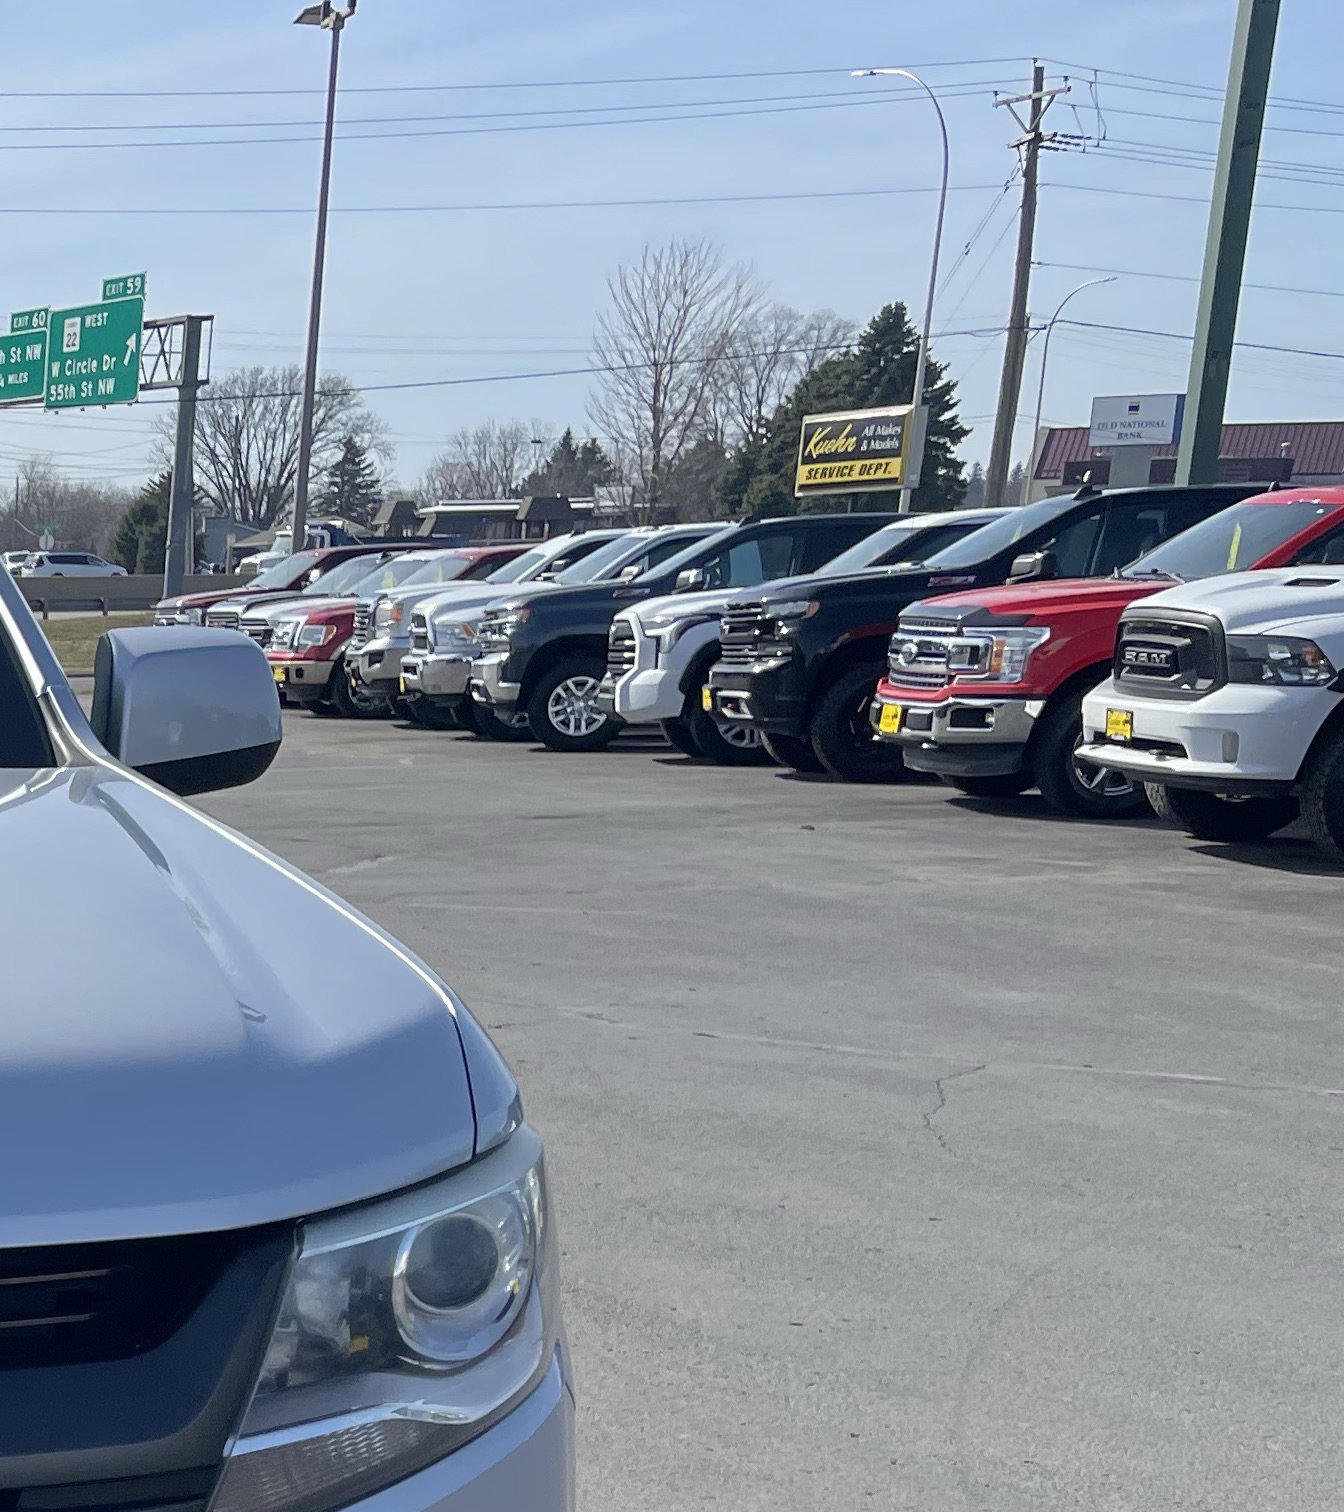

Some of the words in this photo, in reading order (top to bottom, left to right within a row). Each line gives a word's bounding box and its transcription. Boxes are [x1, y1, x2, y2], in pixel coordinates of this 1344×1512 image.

[106, 282, 123, 296] EXIT
[126, 277, 142, 295] 59
[14, 315, 29, 328] EXIT
[32, 311, 46, 327] 60
[85, 312, 108, 328] WEST
[65, 332, 77, 348] 22
[10, 347, 22, 363] St
[26, 343, 42, 361] NW
[52, 362, 60, 377] W
[65, 357, 97, 376] Circle
[103, 354, 117, 371] Dr
[50, 384, 76, 401] 55th
[81, 381, 93, 398] St
[98, 378, 115, 396] NW
[861, 426, 874, 437] All
[876, 424, 901, 436] Makes
[1097, 422, 1117, 431] OLD
[1120, 420, 1167, 429] NATIONAL
[804, 423, 857, 459] Kuehn
[1117, 432, 1143, 440] BANK
[861, 440, 867, 451] &
[870, 438, 899, 450] Models
[806, 464, 855, 480] SERVICE
[859, 462, 892, 476] DEPT.
[1124, 651, 1167, 664] RAM
